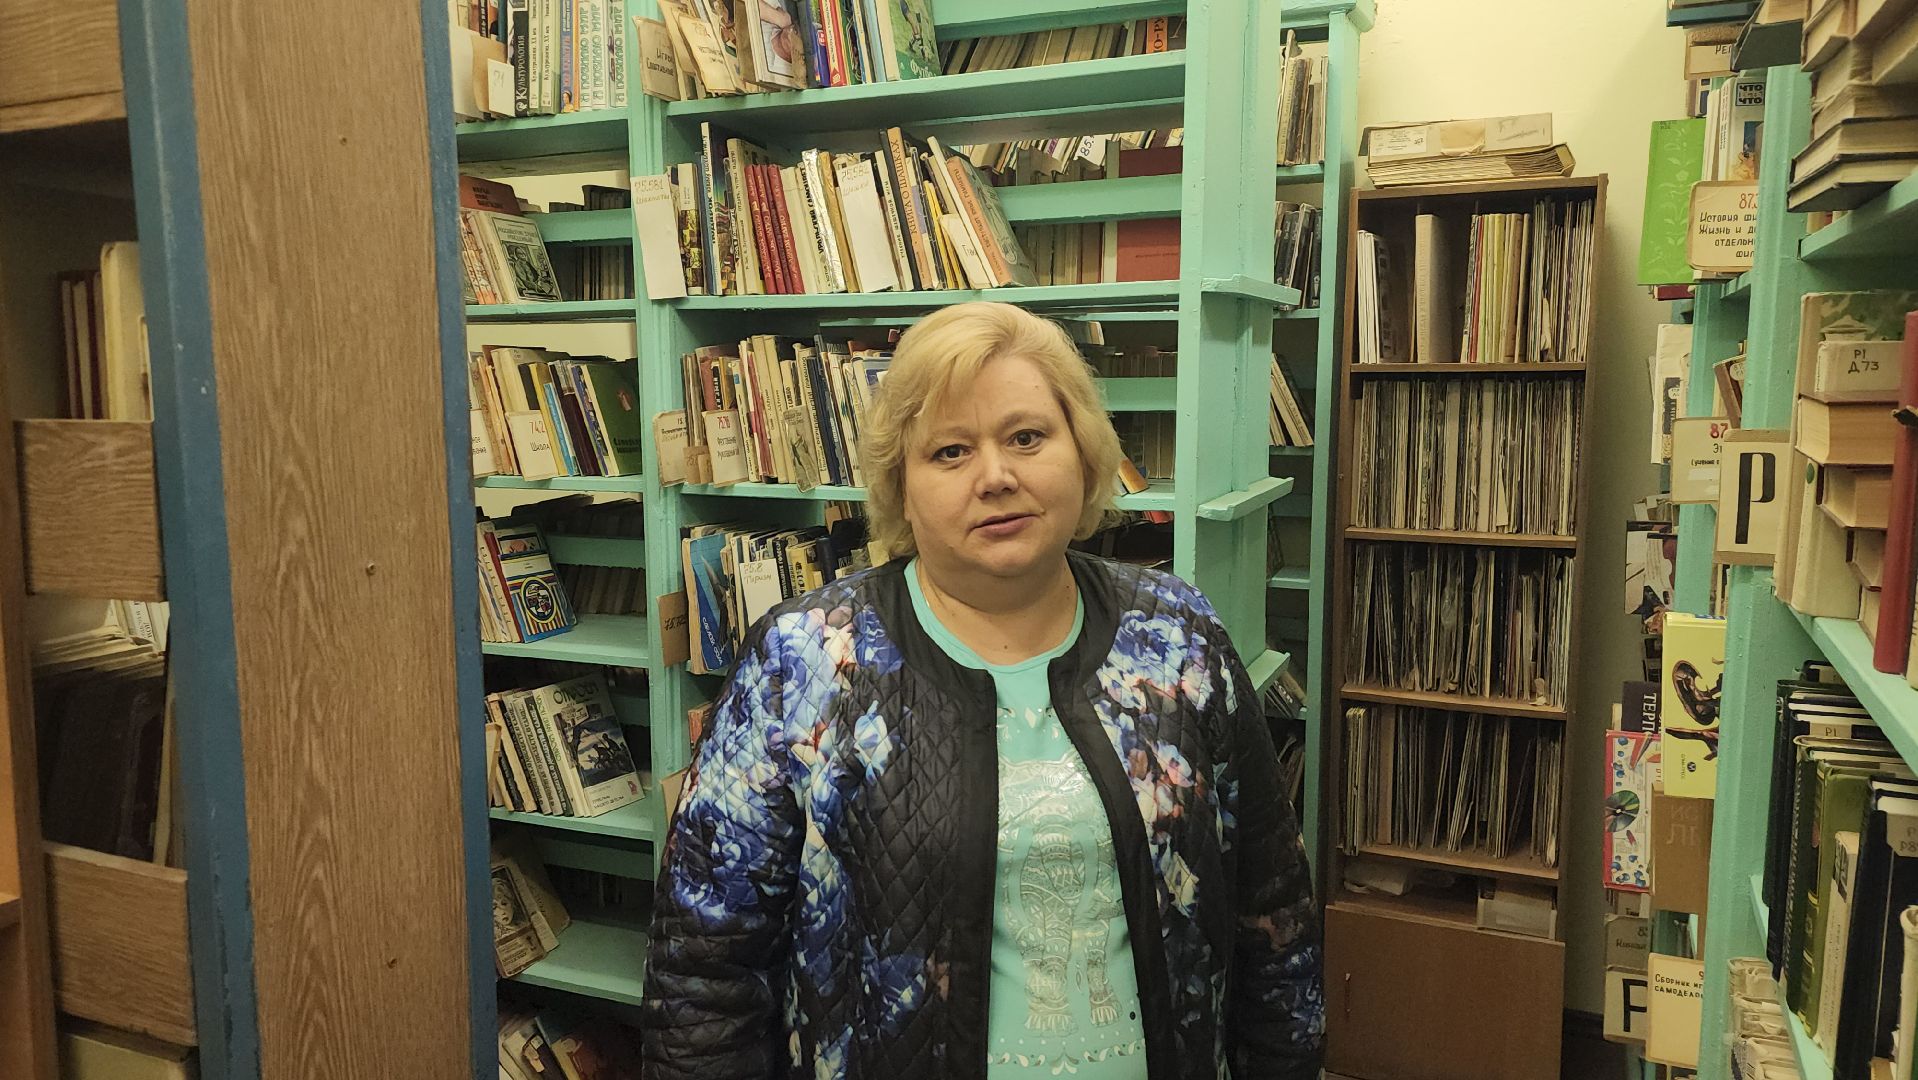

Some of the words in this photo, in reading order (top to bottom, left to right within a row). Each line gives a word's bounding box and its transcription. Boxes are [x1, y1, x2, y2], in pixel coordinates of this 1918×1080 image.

[1080, 135, 1095, 156] 85.
[890, 138, 908, 189] ШАШКАХ
[900, 189, 910, 200] О
[903, 199, 918, 235] КНИГА
[1700, 212, 1738, 222] История
[1699, 225, 1731, 235] Жизнь
